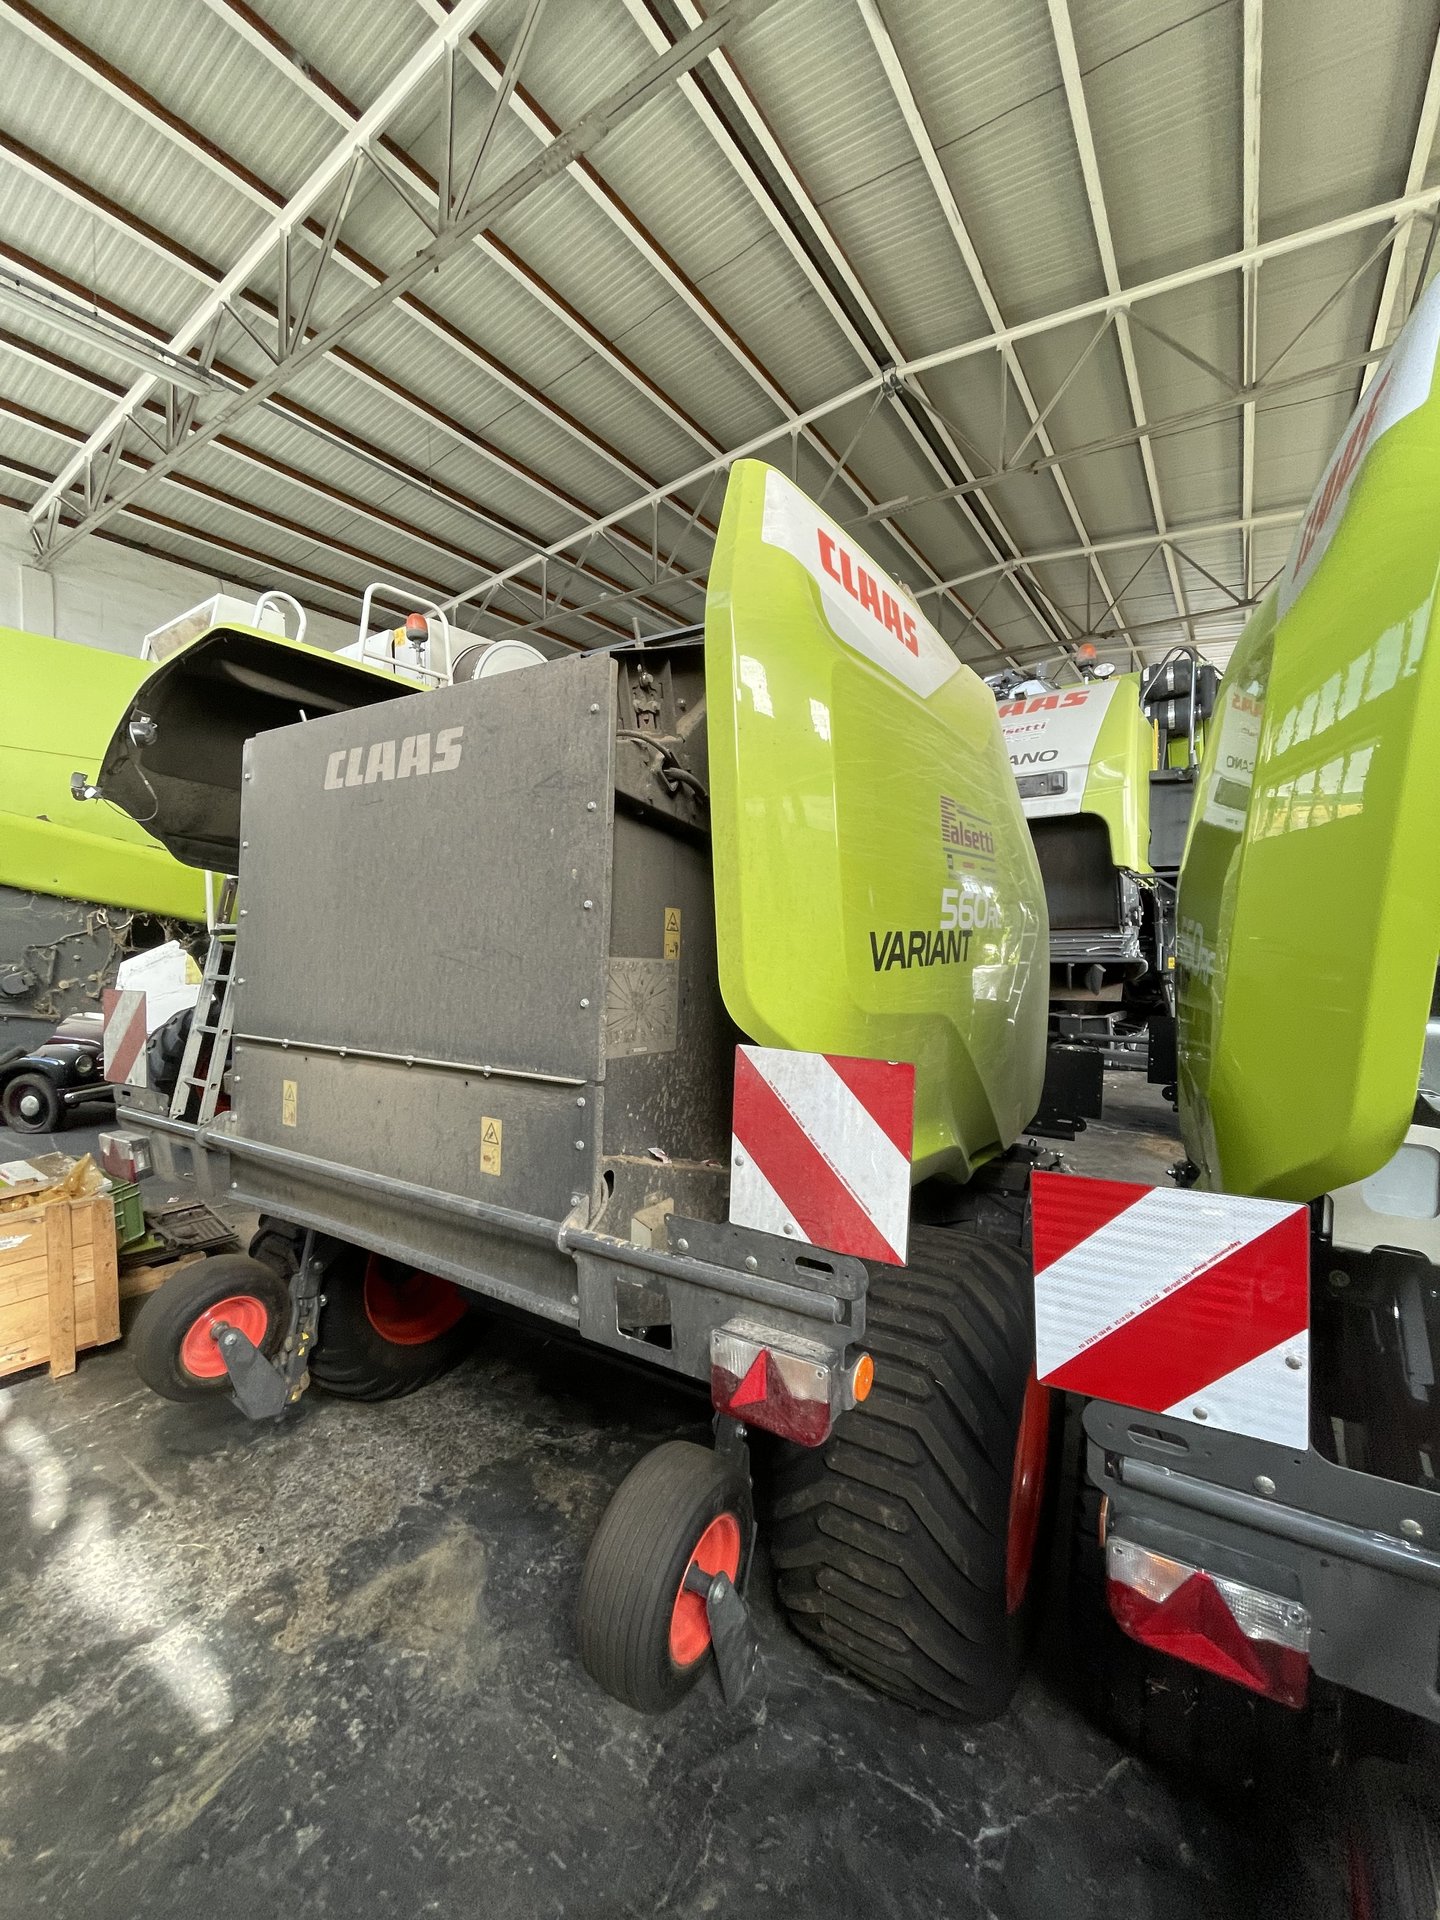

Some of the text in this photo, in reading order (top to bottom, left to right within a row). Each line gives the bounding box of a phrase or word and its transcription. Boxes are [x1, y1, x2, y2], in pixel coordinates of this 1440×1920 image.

[817, 527, 919, 658] CLAAS
[998, 689, 1091, 718] AAS
[323, 726, 465, 790] CLAAS
[1009, 749, 1059, 766] ANO
[869, 929, 974, 972] VARIANT
